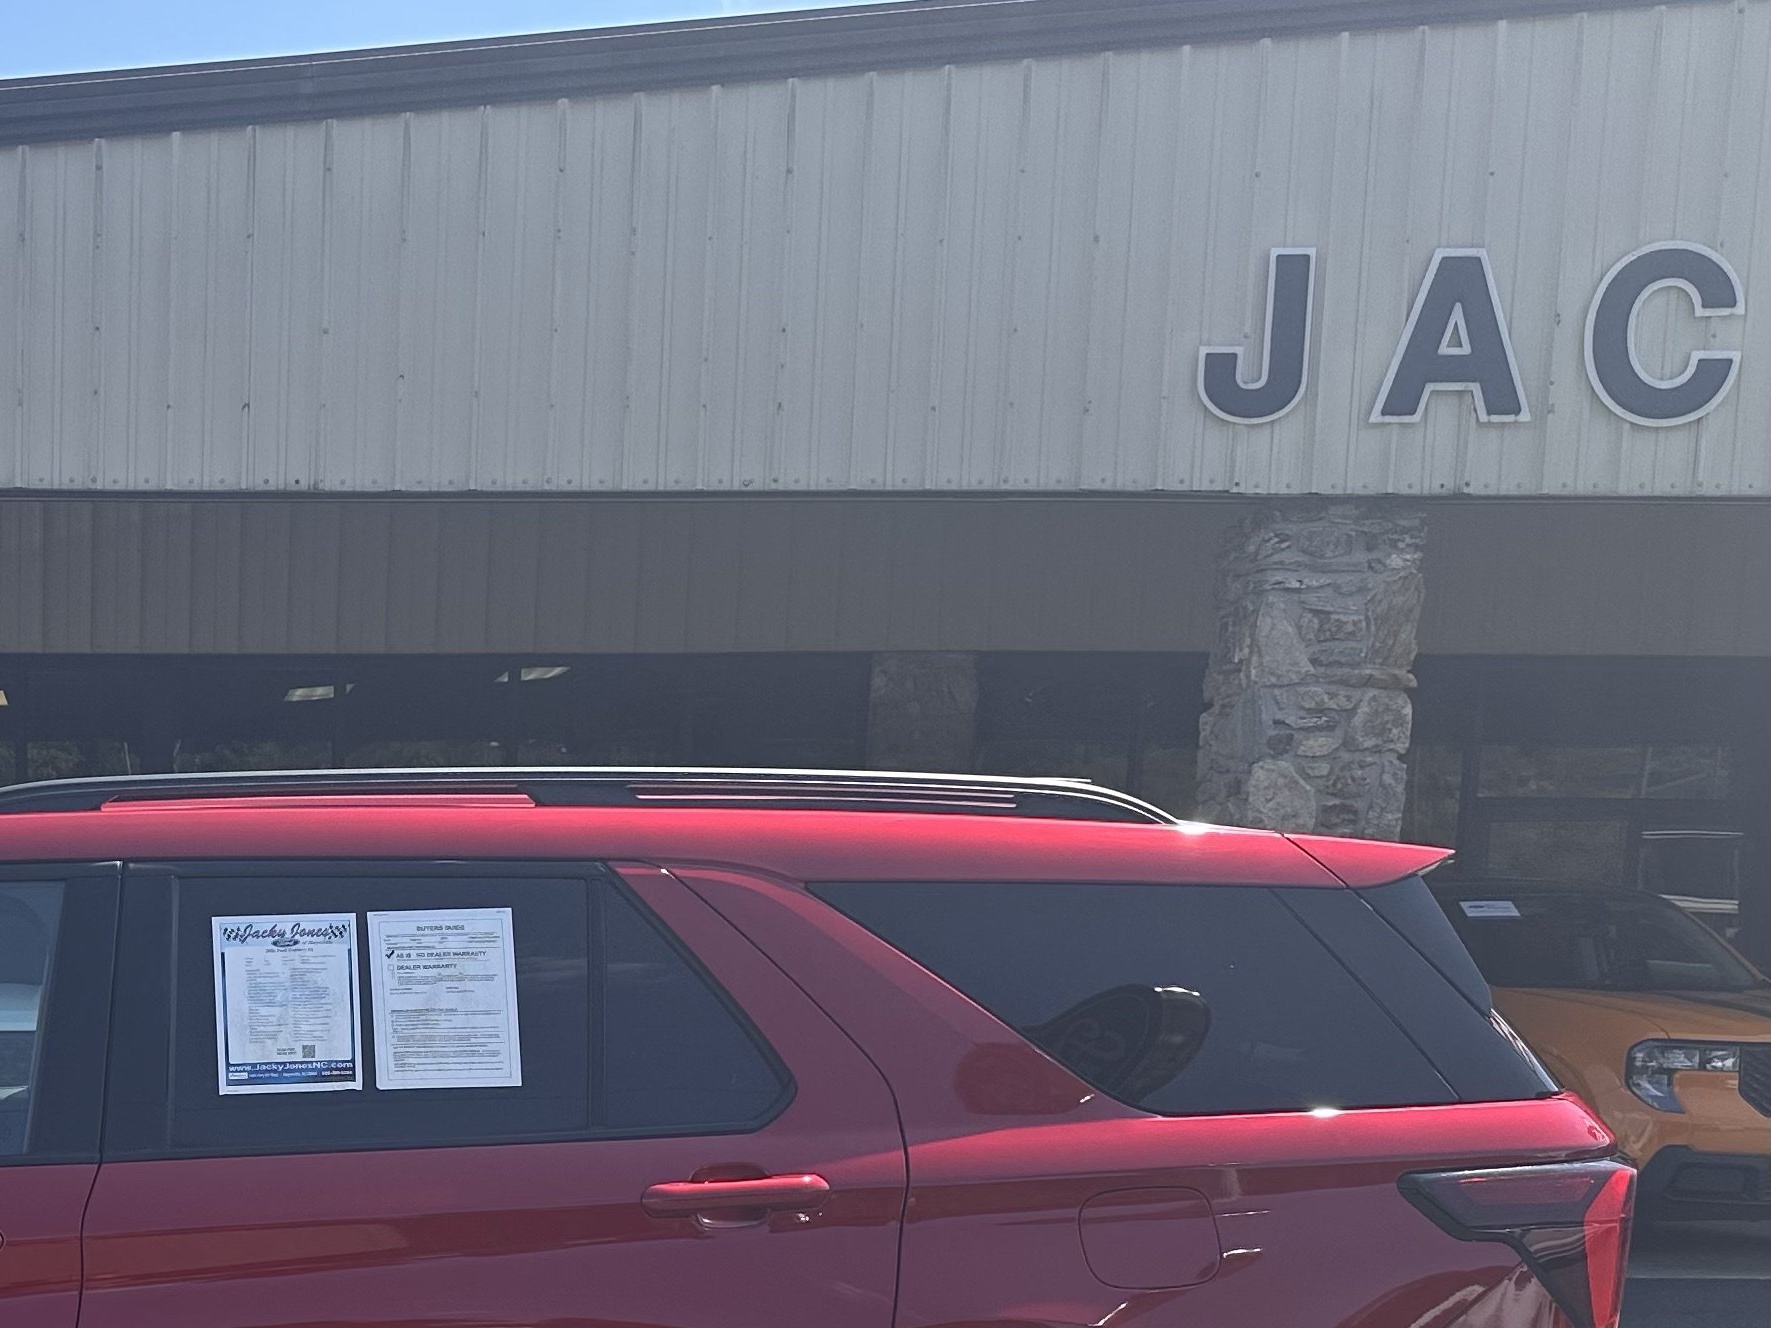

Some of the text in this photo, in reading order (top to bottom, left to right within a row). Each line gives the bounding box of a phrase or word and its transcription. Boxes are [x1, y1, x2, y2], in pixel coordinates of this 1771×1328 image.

[1197, 240, 1745, 427] JAC
[239, 922, 329, 944] Jacky Jones
